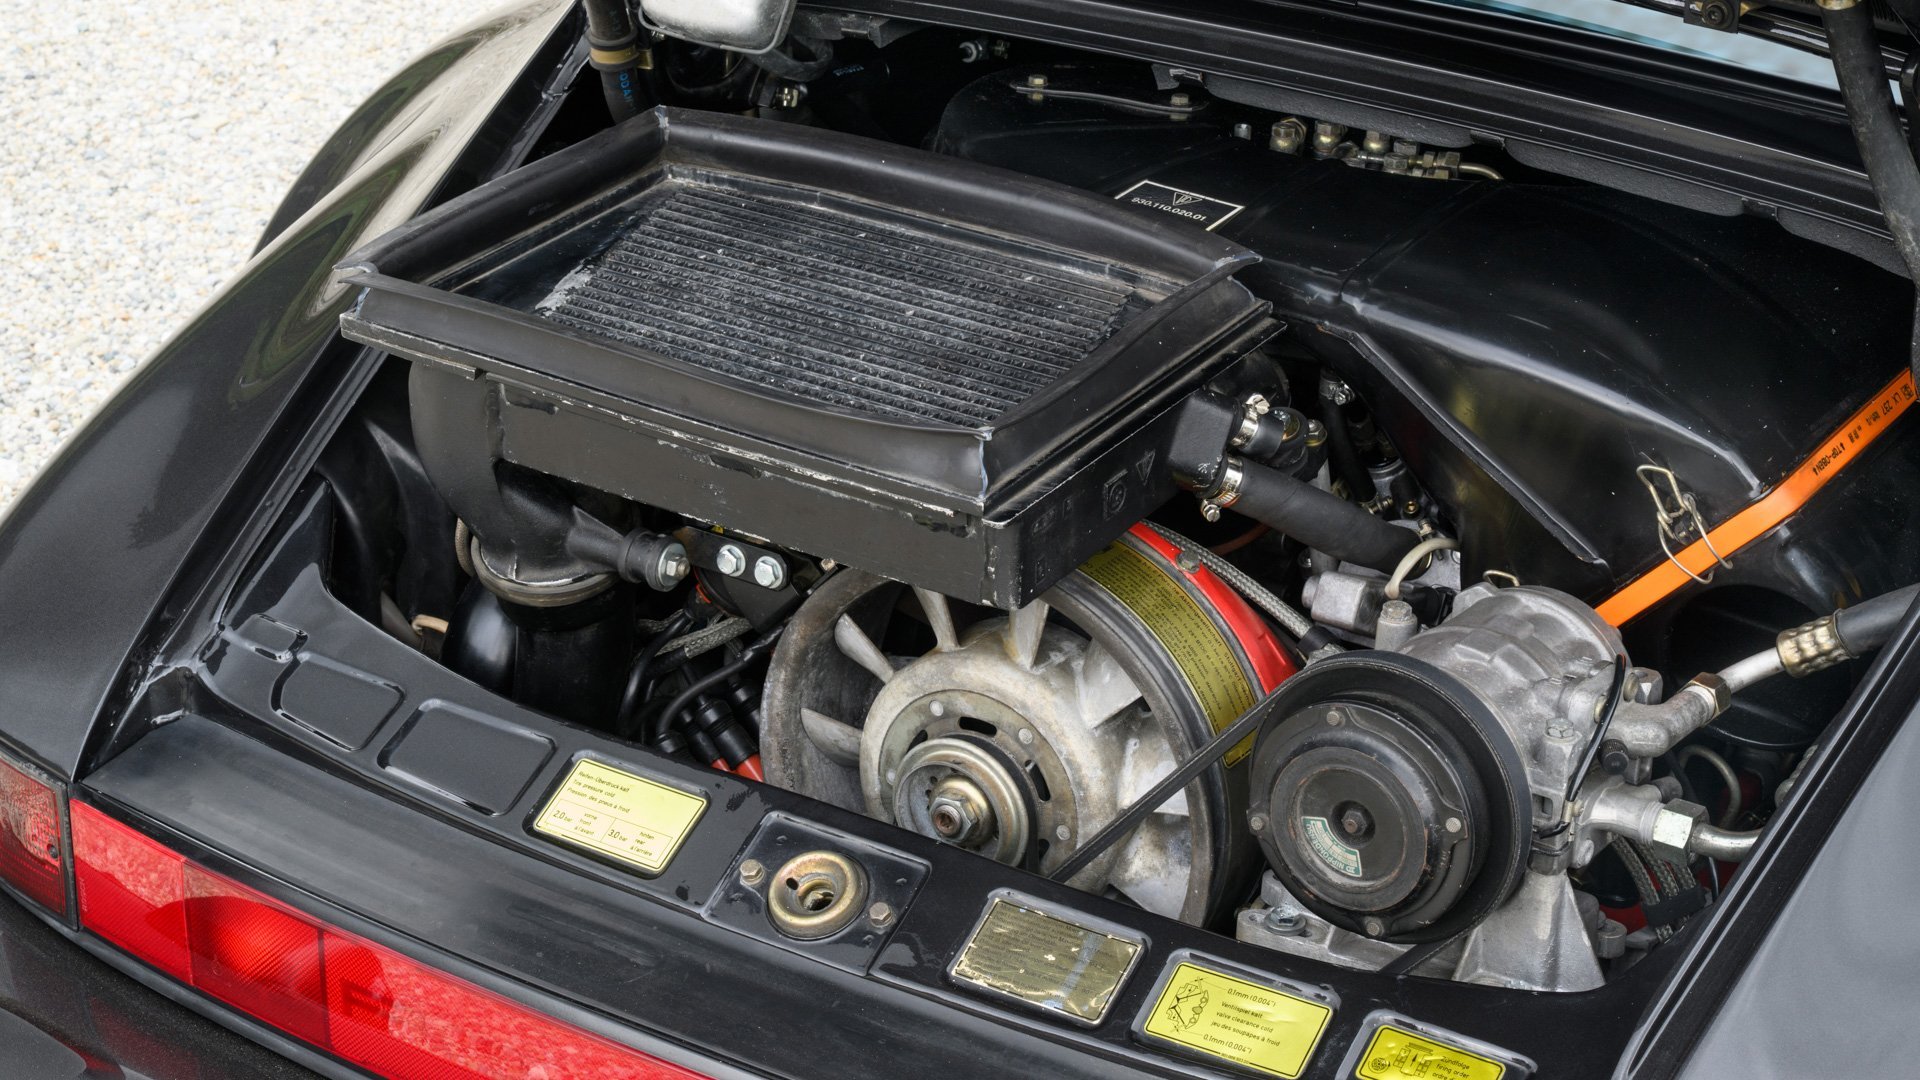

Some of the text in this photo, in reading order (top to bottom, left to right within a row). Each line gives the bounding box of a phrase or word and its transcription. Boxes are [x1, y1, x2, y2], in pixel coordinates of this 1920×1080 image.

[1131, 197, 1207, 221] 930.110.020.01
[583, 782, 603, 794] pressure
[604, 790, 616, 798] cold
[618, 804, 630, 813] froid
[607, 829, 620, 839] 3.0
[1221, 1001, 1263, 1018] Ventilspiel kalt
[1216, 1011, 1274, 1033] valve clearance cold
[1211, 1020, 1221, 1028] jeu
[1222, 1023, 1231, 1031] des
[1232, 1028, 1260, 1041] soupapes
[1266, 1038, 1280, 1047] froid
[1437, 1064, 1451, 1074] firing
[1453, 1070, 1469, 1078] order
